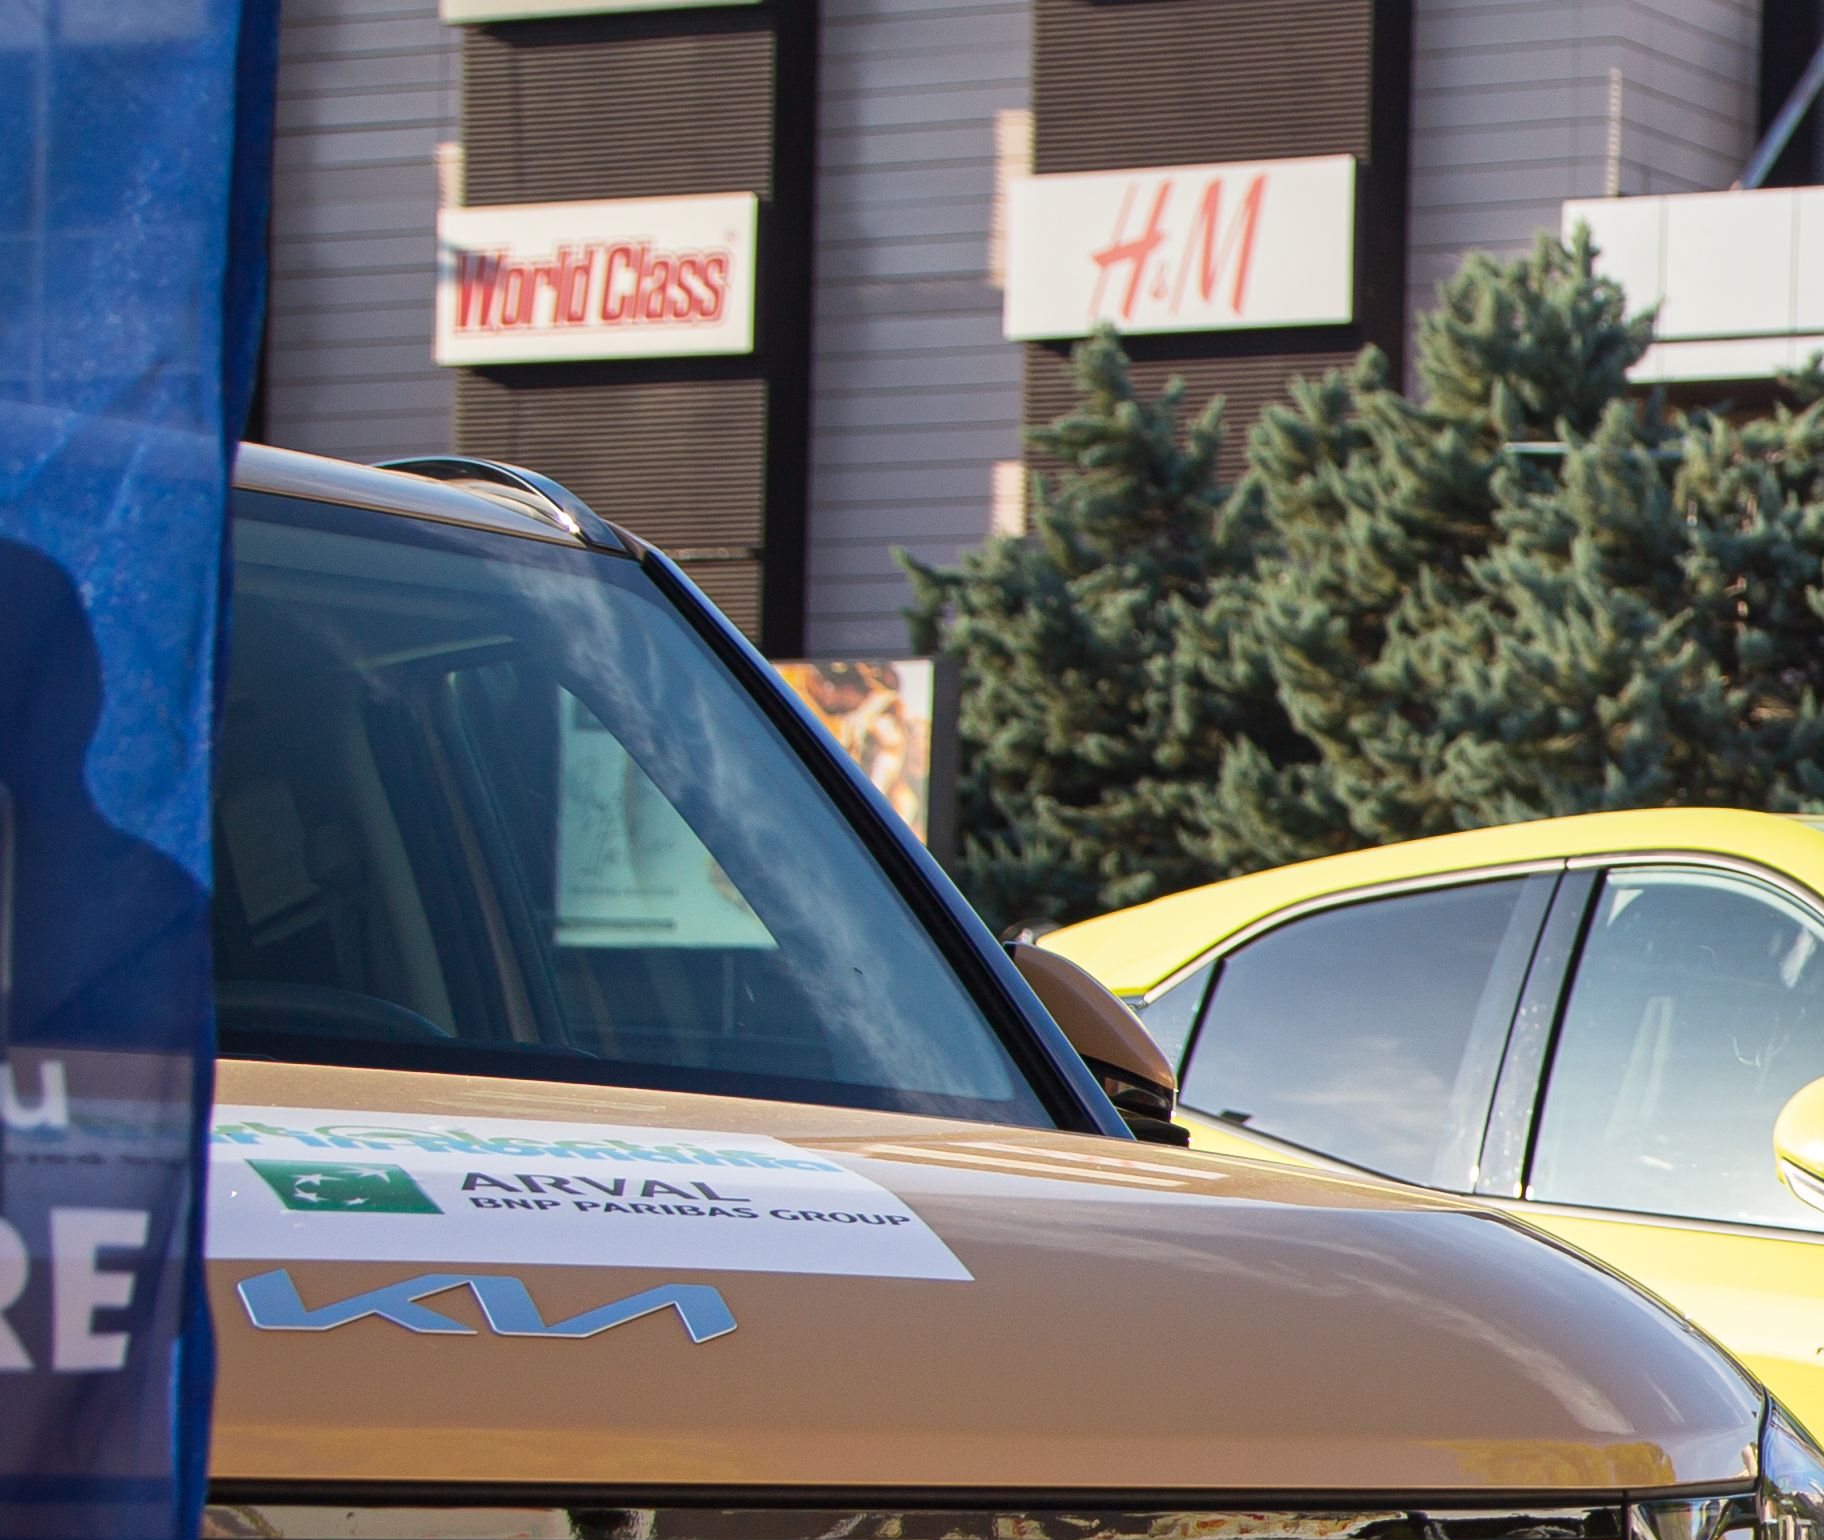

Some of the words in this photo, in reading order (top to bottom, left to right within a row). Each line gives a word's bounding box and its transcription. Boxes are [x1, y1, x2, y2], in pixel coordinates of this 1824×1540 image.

[1090, 171, 1269, 321] H&M
[455, 243, 597, 332] World
[598, 238, 730, 326] Class
[460, 1171, 752, 1202] ARVAL
[470, 1196, 562, 1212] BNP
[577, 1200, 761, 1219] PARIBAS
[768, 1207, 911, 1227] GROUP
